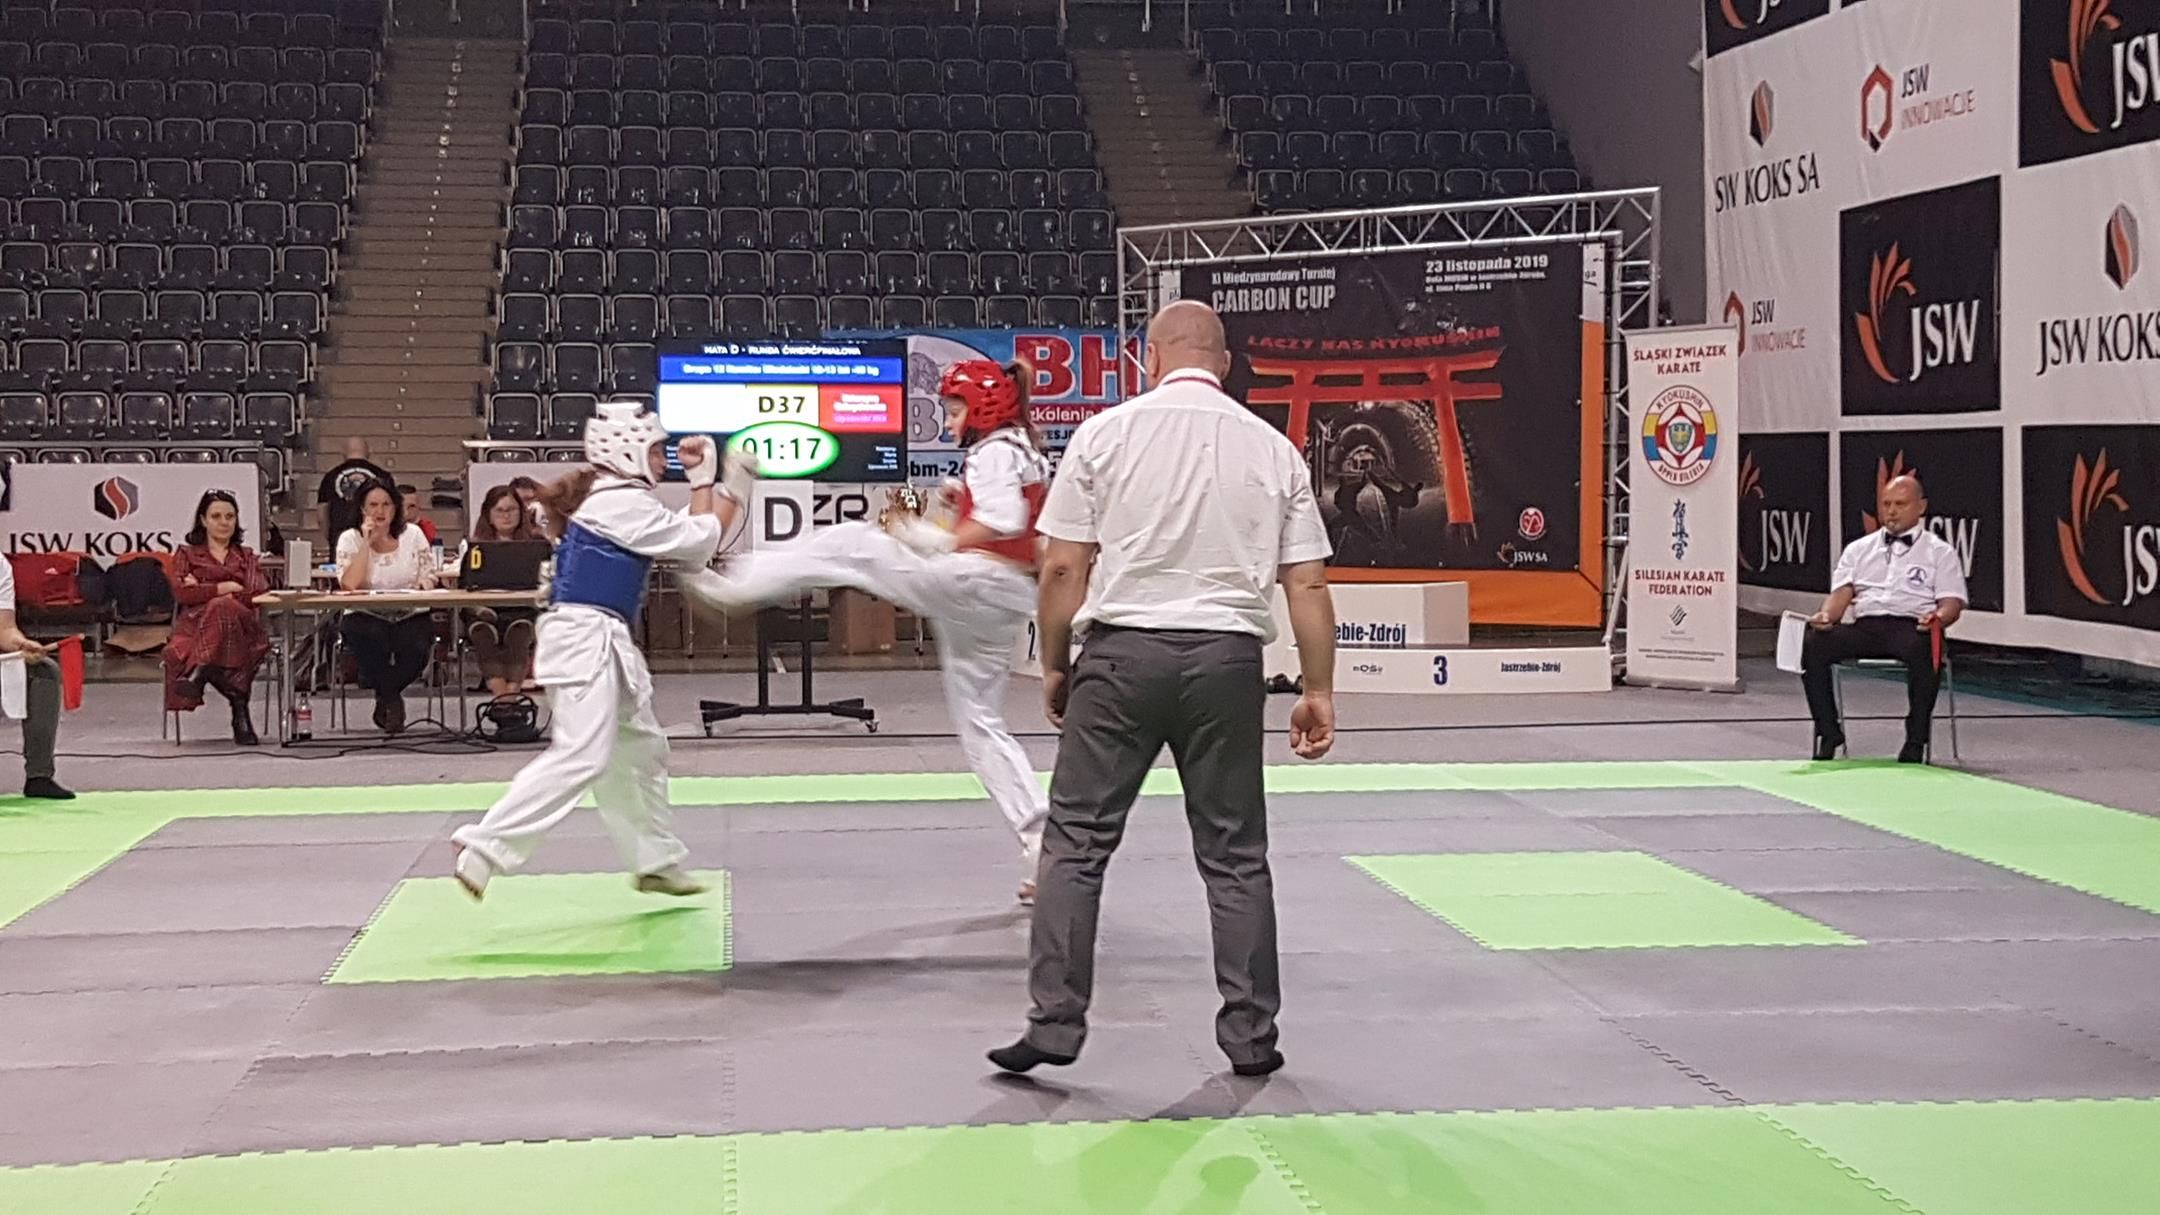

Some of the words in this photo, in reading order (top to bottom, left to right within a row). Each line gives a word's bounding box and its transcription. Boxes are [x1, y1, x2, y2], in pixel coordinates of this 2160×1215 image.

[1902, 64, 1929, 98] JSW
[1714, 171, 1739, 209] SW
[1744, 158, 1791, 206] KOKS
[1797, 152, 1819, 194] SA
[1301, 266, 1336, 281] Turniej
[1426, 261, 1443, 273] 23
[1446, 257, 1511, 272] listopada
[1514, 254, 1548, 268] 2019
[1212, 287, 1290, 313] CARBON
[1296, 285, 1336, 304] CUP
[1750, 299, 1775, 325] JSW
[1321, 339, 1362, 351] NAS
[1675, 344, 1727, 359] ZWIĄZEK
[1909, 300, 1979, 381] JSW
[2036, 317, 2090, 376] JSW
[1657, 361, 1701, 375] KARATE
[758, 396, 806, 414] D37
[1656, 389, 1704, 410] KYOKUSHIN
[742, 437, 822, 461] 01:17
[764, 497, 803, 541] D
[1760, 510, 1810, 572] JSW
[1635, 569, 1681, 581] SILESIAN
[1684, 570, 1725, 583] KARATE
[2122, 524, 2160, 607] JS
[1649, 584, 1713, 597] FEDERATION
[1334, 622, 1406, 649] ebie-Zdrój
[1433, 655, 1448, 686] 3
